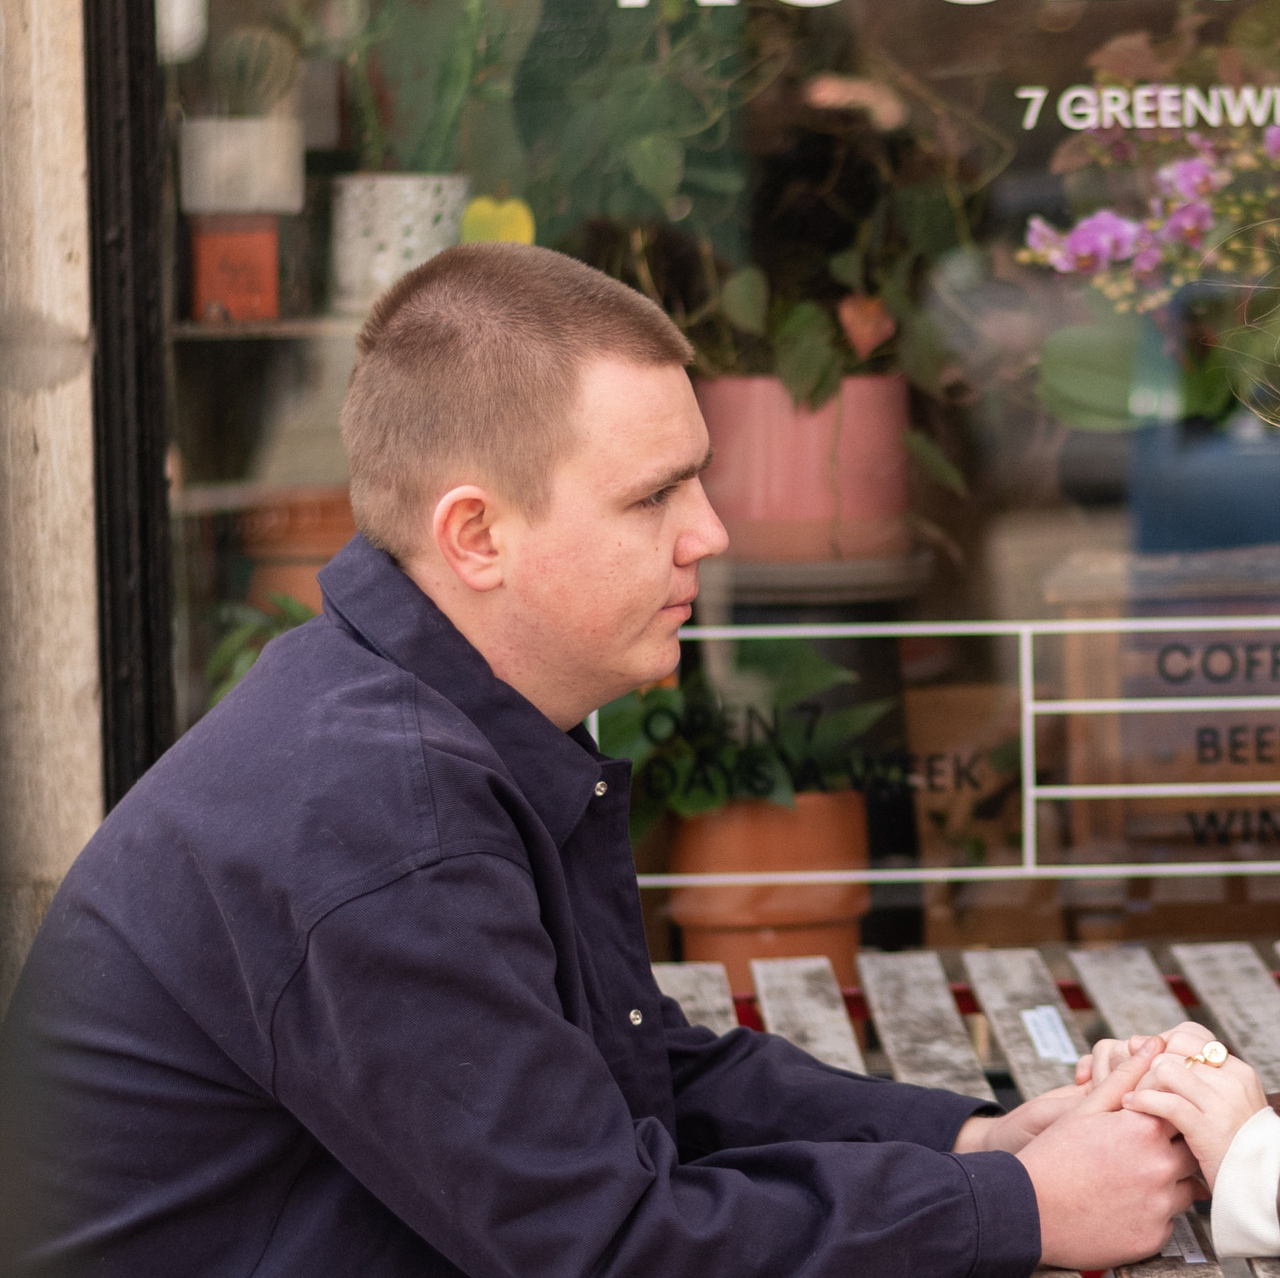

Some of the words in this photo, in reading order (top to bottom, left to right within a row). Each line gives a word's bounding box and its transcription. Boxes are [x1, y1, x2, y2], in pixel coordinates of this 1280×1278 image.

[1015, 85, 1049, 130] 7
[643, 702, 780, 745] OPEN
[799, 702, 823, 745] 7
[643, 753, 776, 799] DAYS
